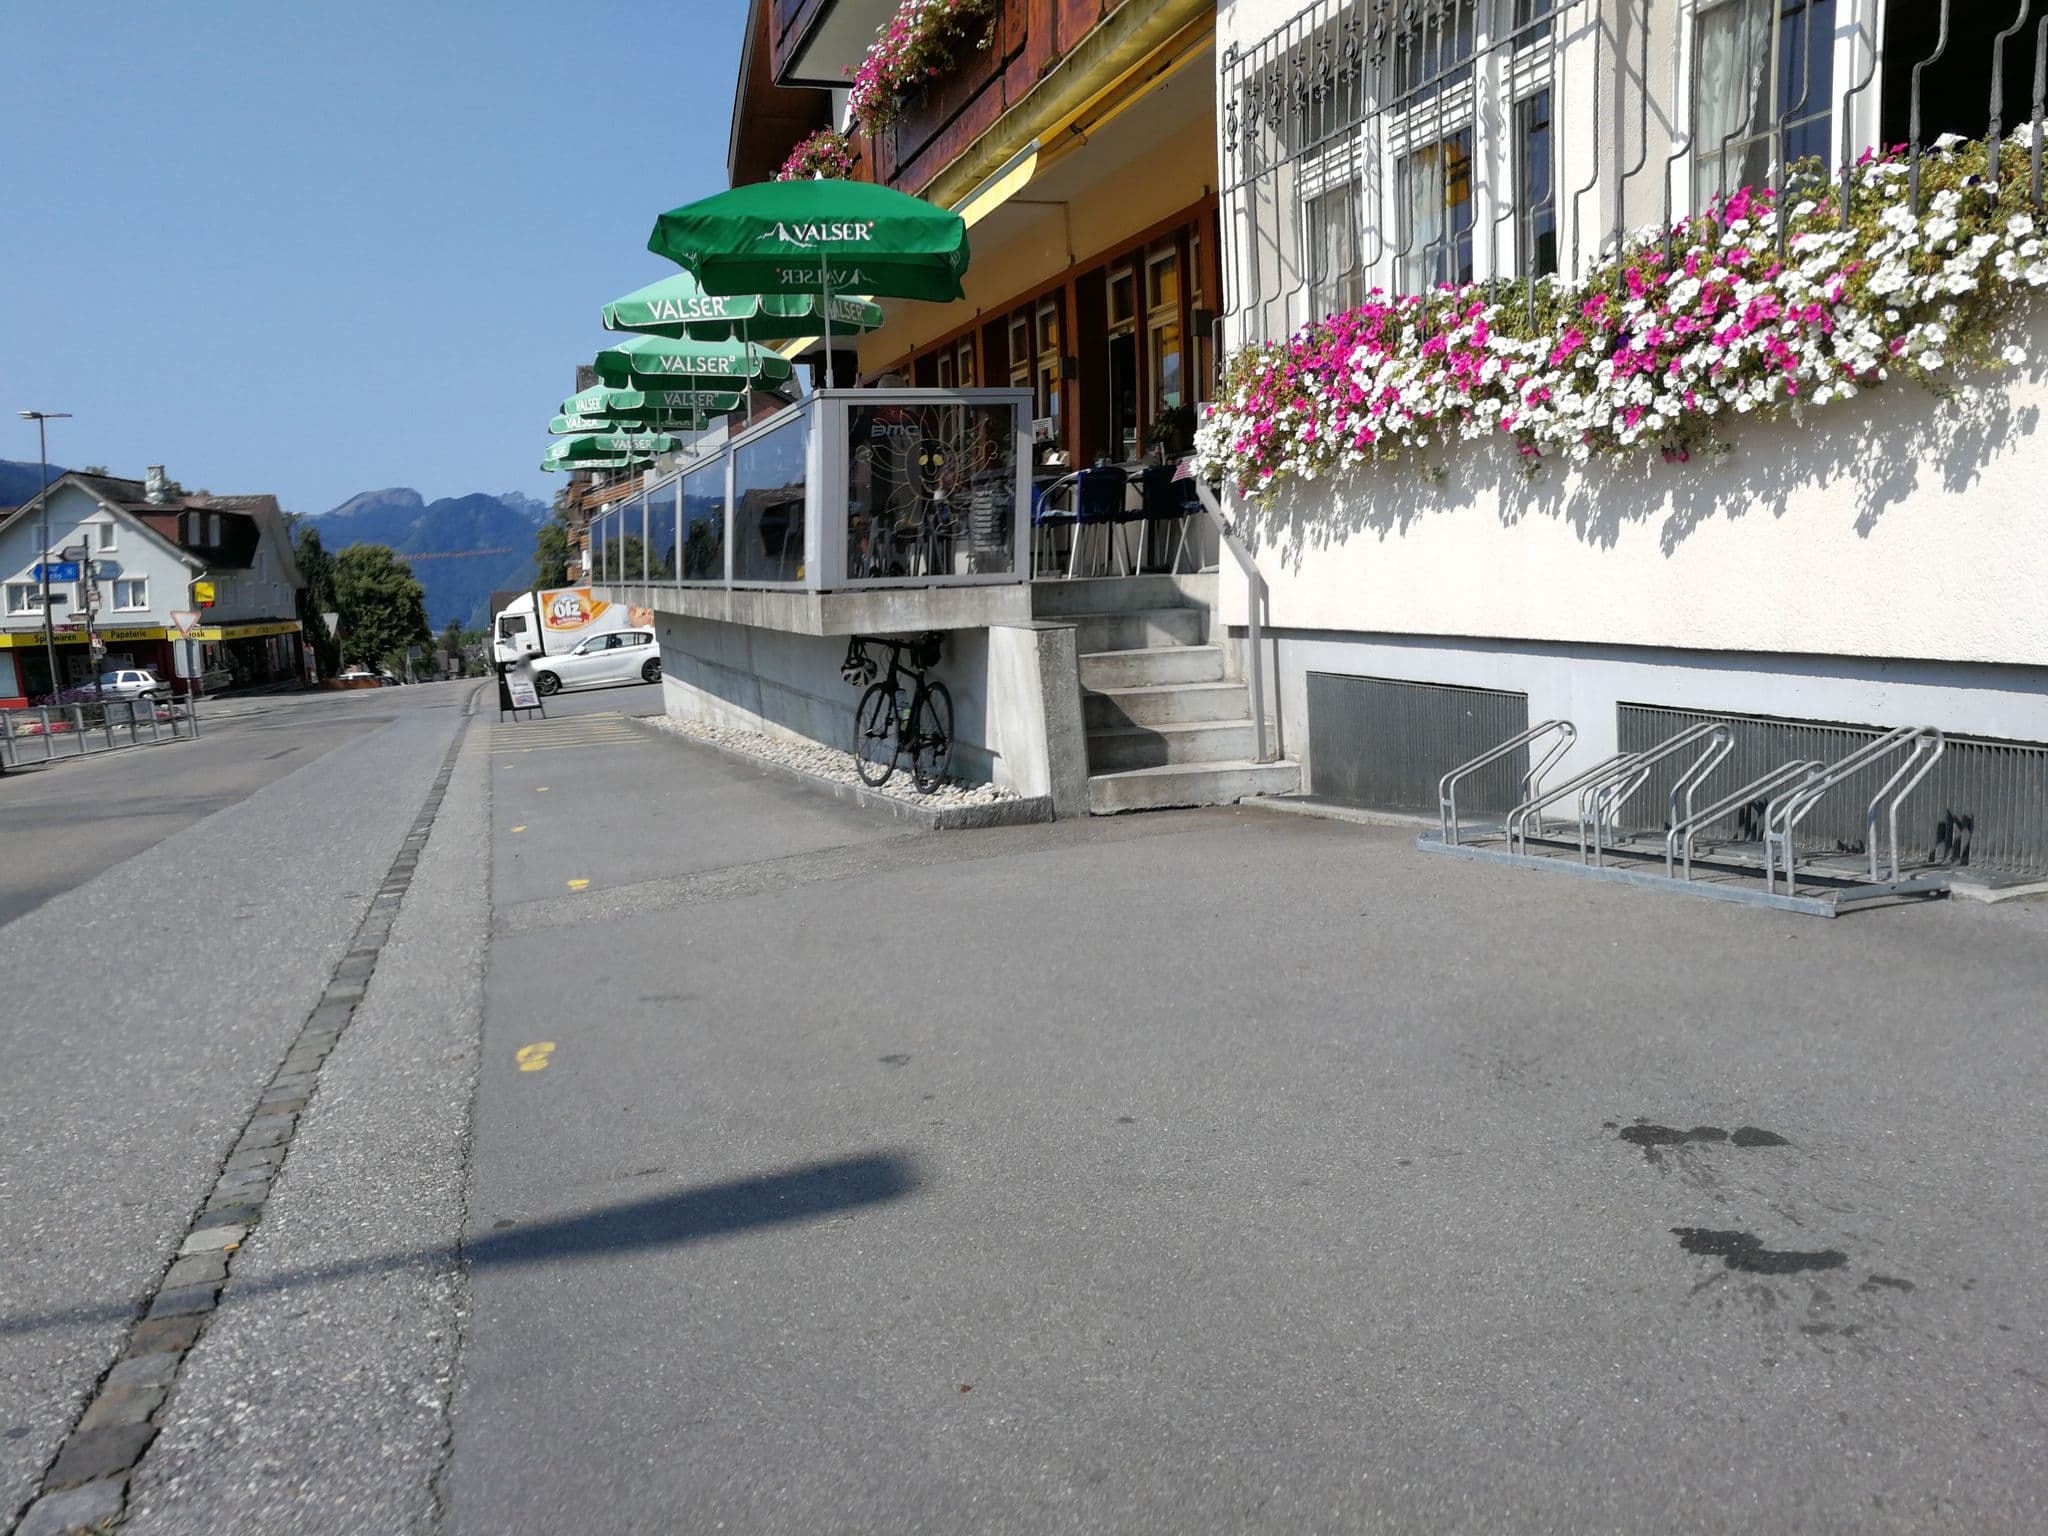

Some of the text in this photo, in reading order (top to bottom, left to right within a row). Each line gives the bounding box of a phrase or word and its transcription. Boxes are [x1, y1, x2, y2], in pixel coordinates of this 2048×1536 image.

[793, 223, 870, 241] VALSER
[647, 296, 726, 320] VALSER
[660, 356, 729, 373] VALSER
[575, 397, 601, 412] VALSER
[664, 392, 714, 407] VALSER
[611, 439, 652, 449] VALSER
